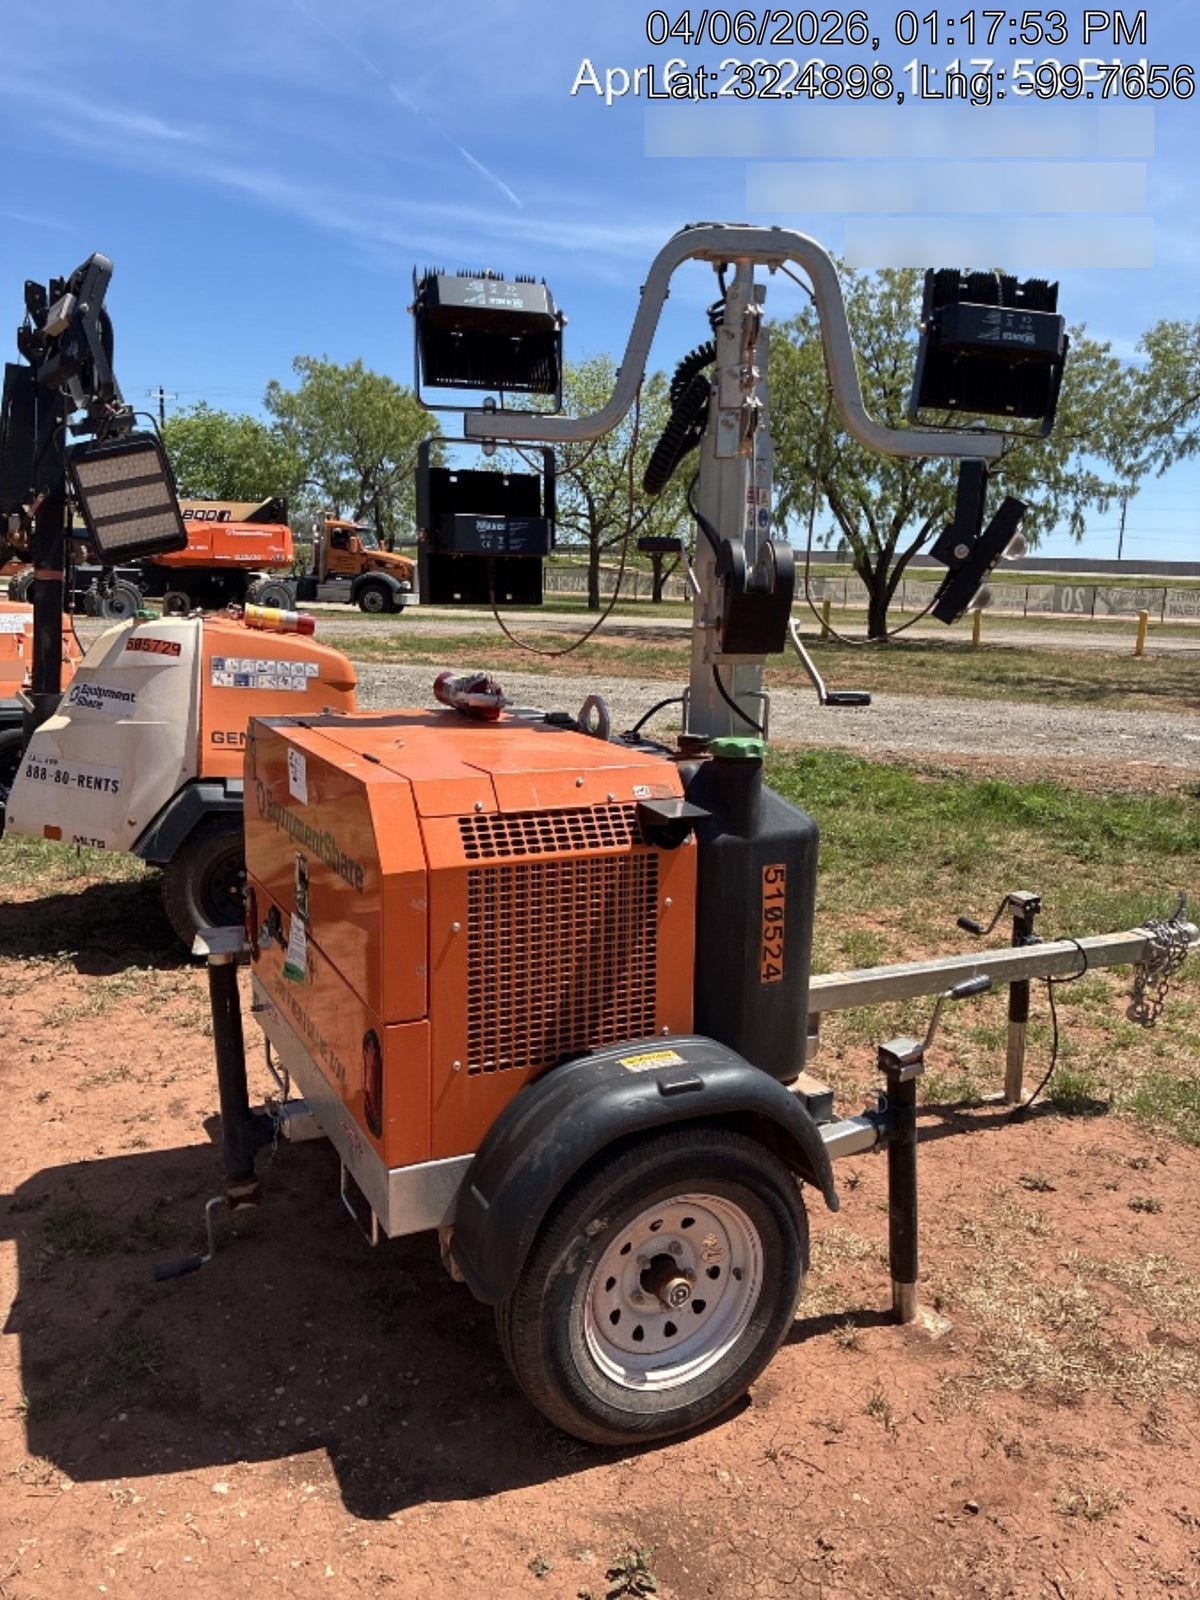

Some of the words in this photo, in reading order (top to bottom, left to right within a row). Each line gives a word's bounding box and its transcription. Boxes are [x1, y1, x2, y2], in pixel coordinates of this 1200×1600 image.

[81, 684, 136, 703] Equipment
[26, 764, 120, 793] 888-80-RENTS
[763, 866, 785, 980] 510524
